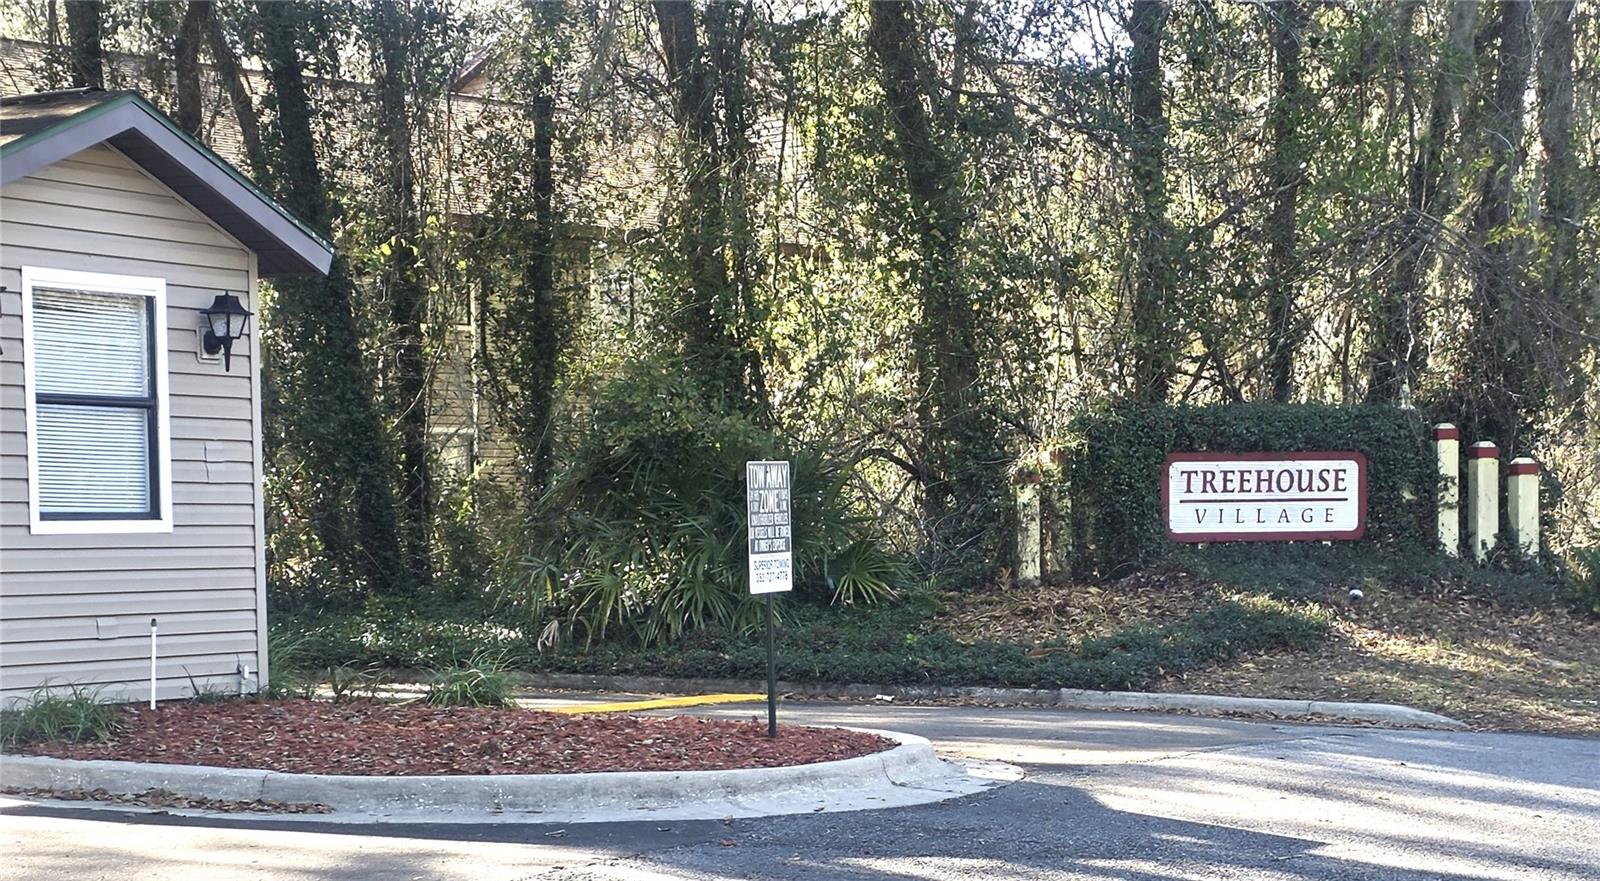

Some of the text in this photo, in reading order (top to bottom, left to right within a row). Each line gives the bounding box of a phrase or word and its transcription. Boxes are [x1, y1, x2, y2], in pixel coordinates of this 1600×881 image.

[749, 465, 787, 488] TOW AWAY
[1180, 468, 1347, 494] TREEHOUSE
[759, 490, 779, 513] ZONE
[1194, 507, 1335, 524] VILLAGE
